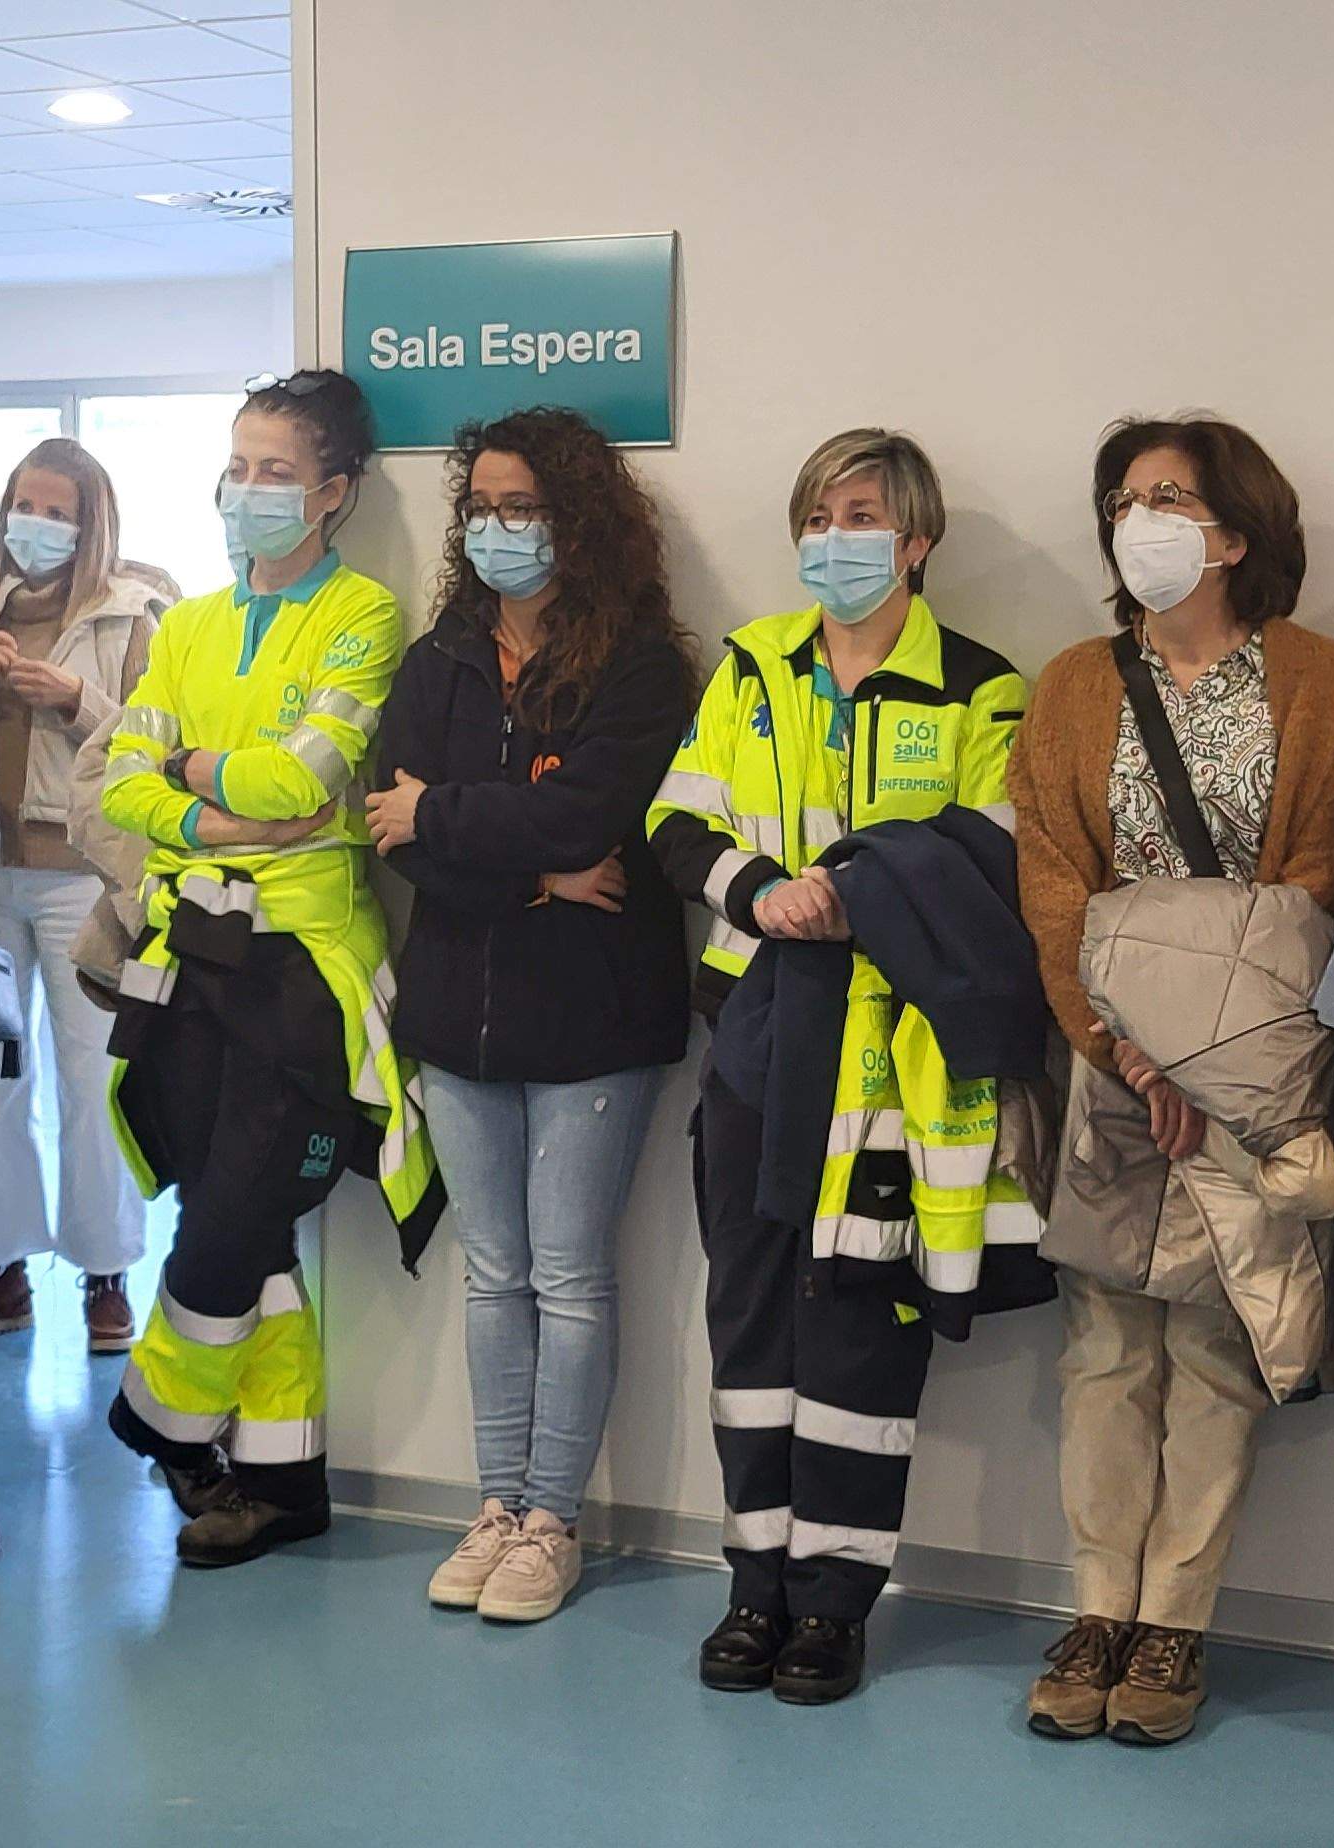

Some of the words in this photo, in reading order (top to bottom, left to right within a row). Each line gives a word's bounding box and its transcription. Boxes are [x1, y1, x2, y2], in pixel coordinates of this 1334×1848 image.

[369, 326, 466, 370] Sala
[480, 323, 642, 373] Espera
[896, 719, 938, 744] 061
[861, 1048, 888, 1072] 06
[308, 1133, 336, 1157] 061
